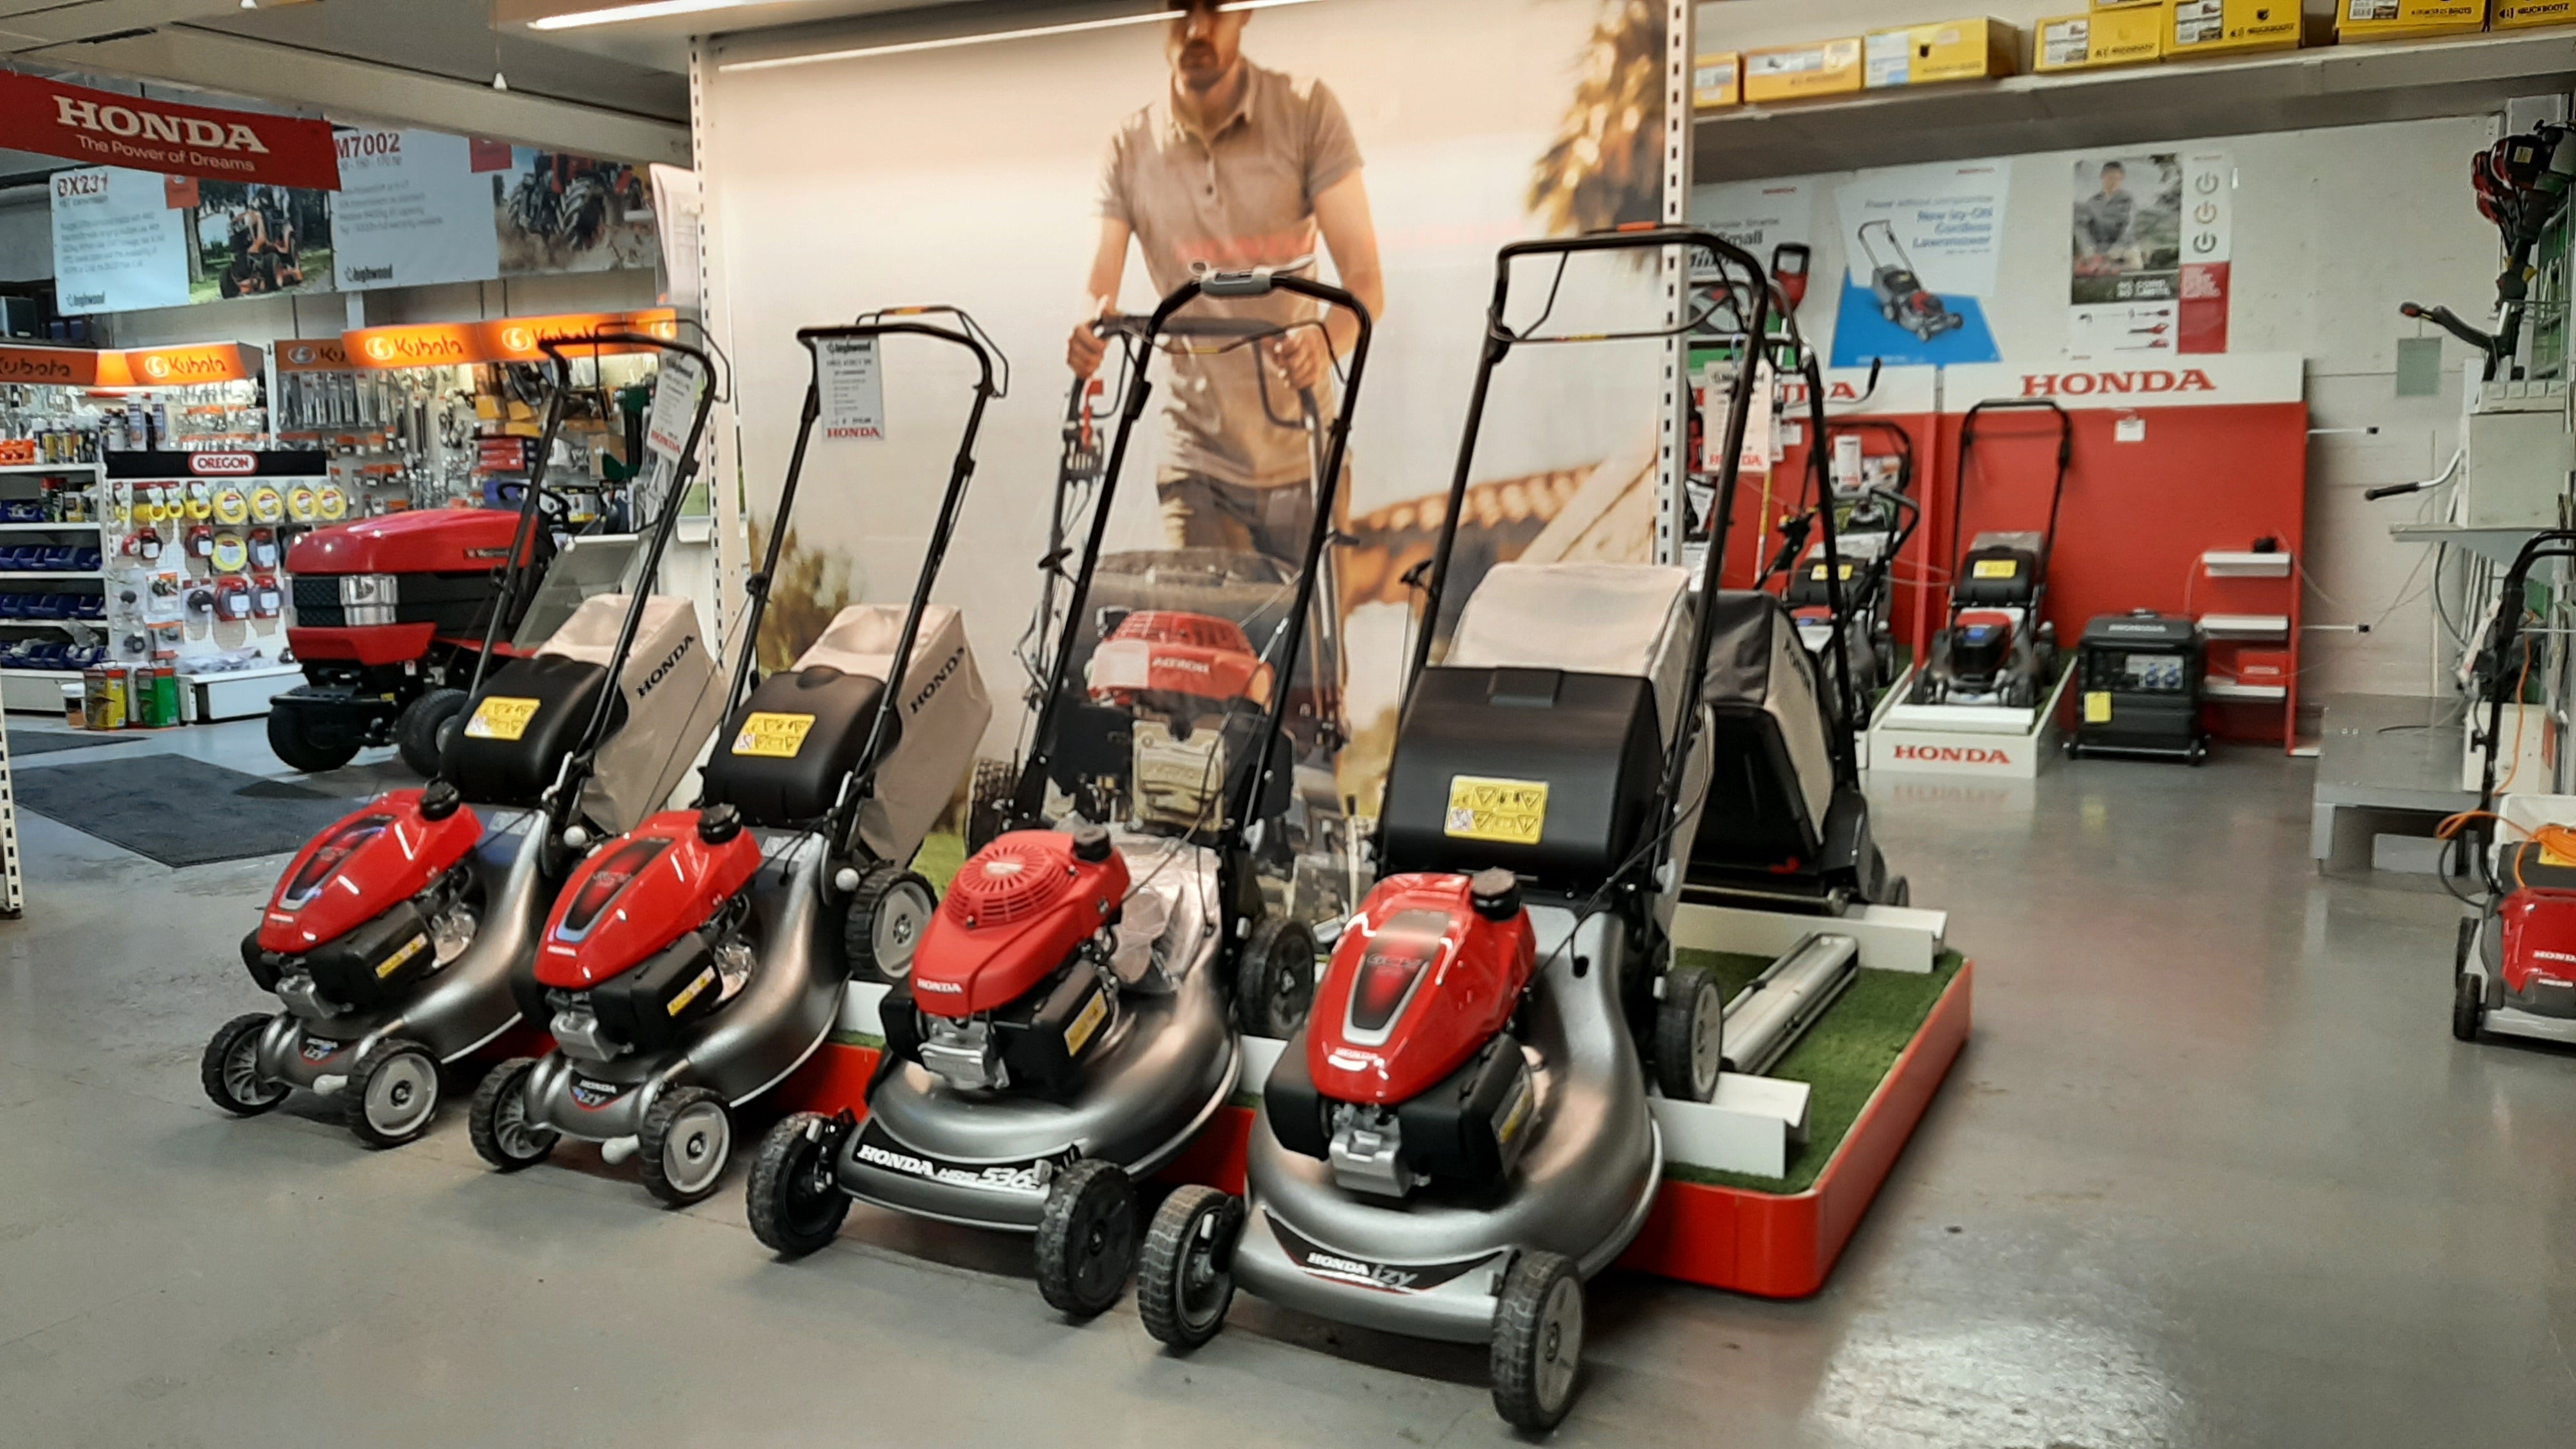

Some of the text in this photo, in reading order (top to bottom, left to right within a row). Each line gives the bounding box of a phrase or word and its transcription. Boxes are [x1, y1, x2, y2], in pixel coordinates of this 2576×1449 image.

[52, 95, 270, 154] HONDA
[76, 134, 256, 172] The Power of Dreams
[335, 132, 401, 158] M7002
[394, 337, 463, 356] Kubota
[168, 353, 226, 374] Kubota
[2021, 369, 2216, 397] HONDA
[827, 427, 880, 438] HONDA
[197, 456, 249, 469] OREGON
[636, 635, 695, 698] HONDA
[1893, 745, 2011, 764] HONDA
[2532, 950, 2576, 963] HOND
[917, 977, 963, 994] HONDA
[857, 1144, 935, 1176] HONDA
[1307, 1252, 1370, 1276] HONDA
